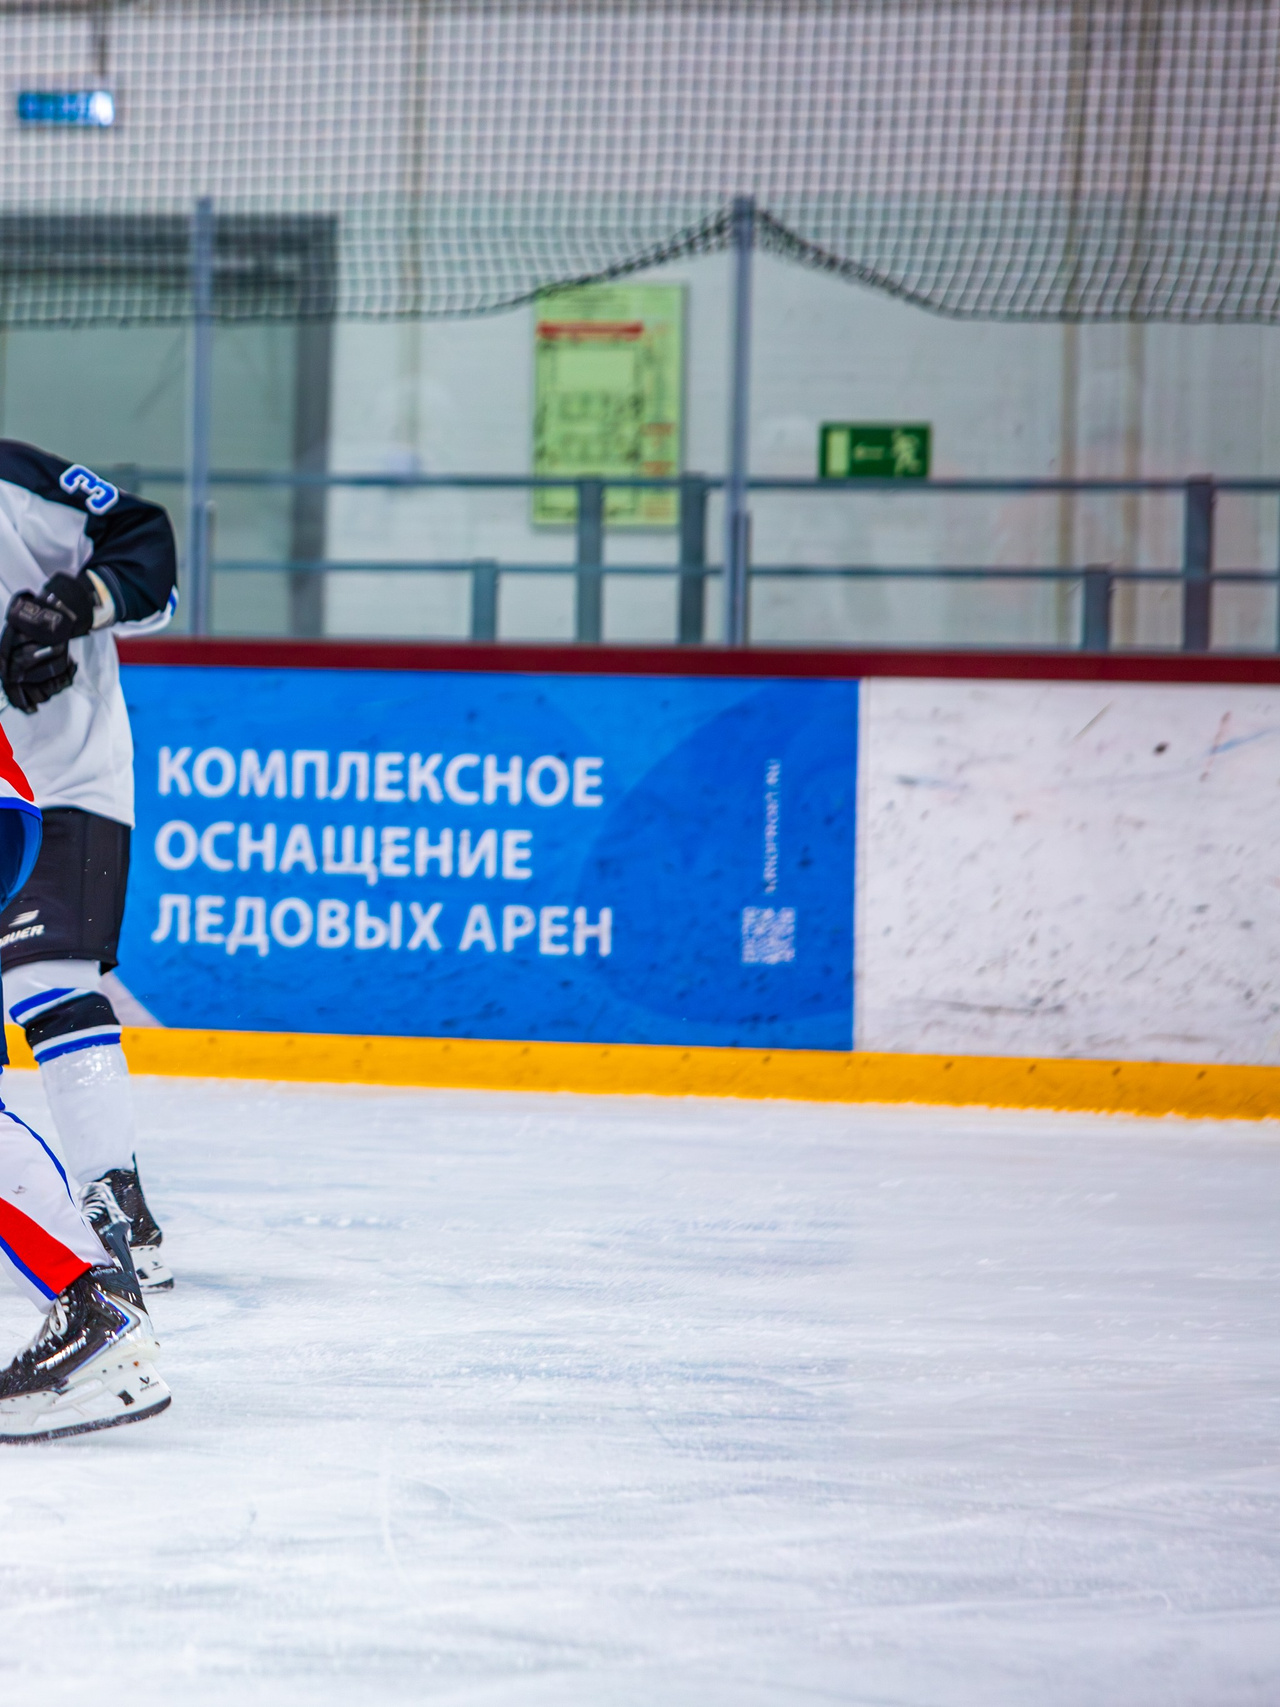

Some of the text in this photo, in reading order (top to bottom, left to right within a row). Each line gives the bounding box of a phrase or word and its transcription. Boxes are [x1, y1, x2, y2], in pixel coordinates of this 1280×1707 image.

[59, 463, 119, 516] 3
[158, 746, 604, 807] КОМПЛЕКСНОЕ
[154, 820, 533, 886] ОСНАЩЕНИЕ
[0, 924, 45, 949] AUER
[151, 894, 613, 957] ЛЕДОВЫХ АРЕН
